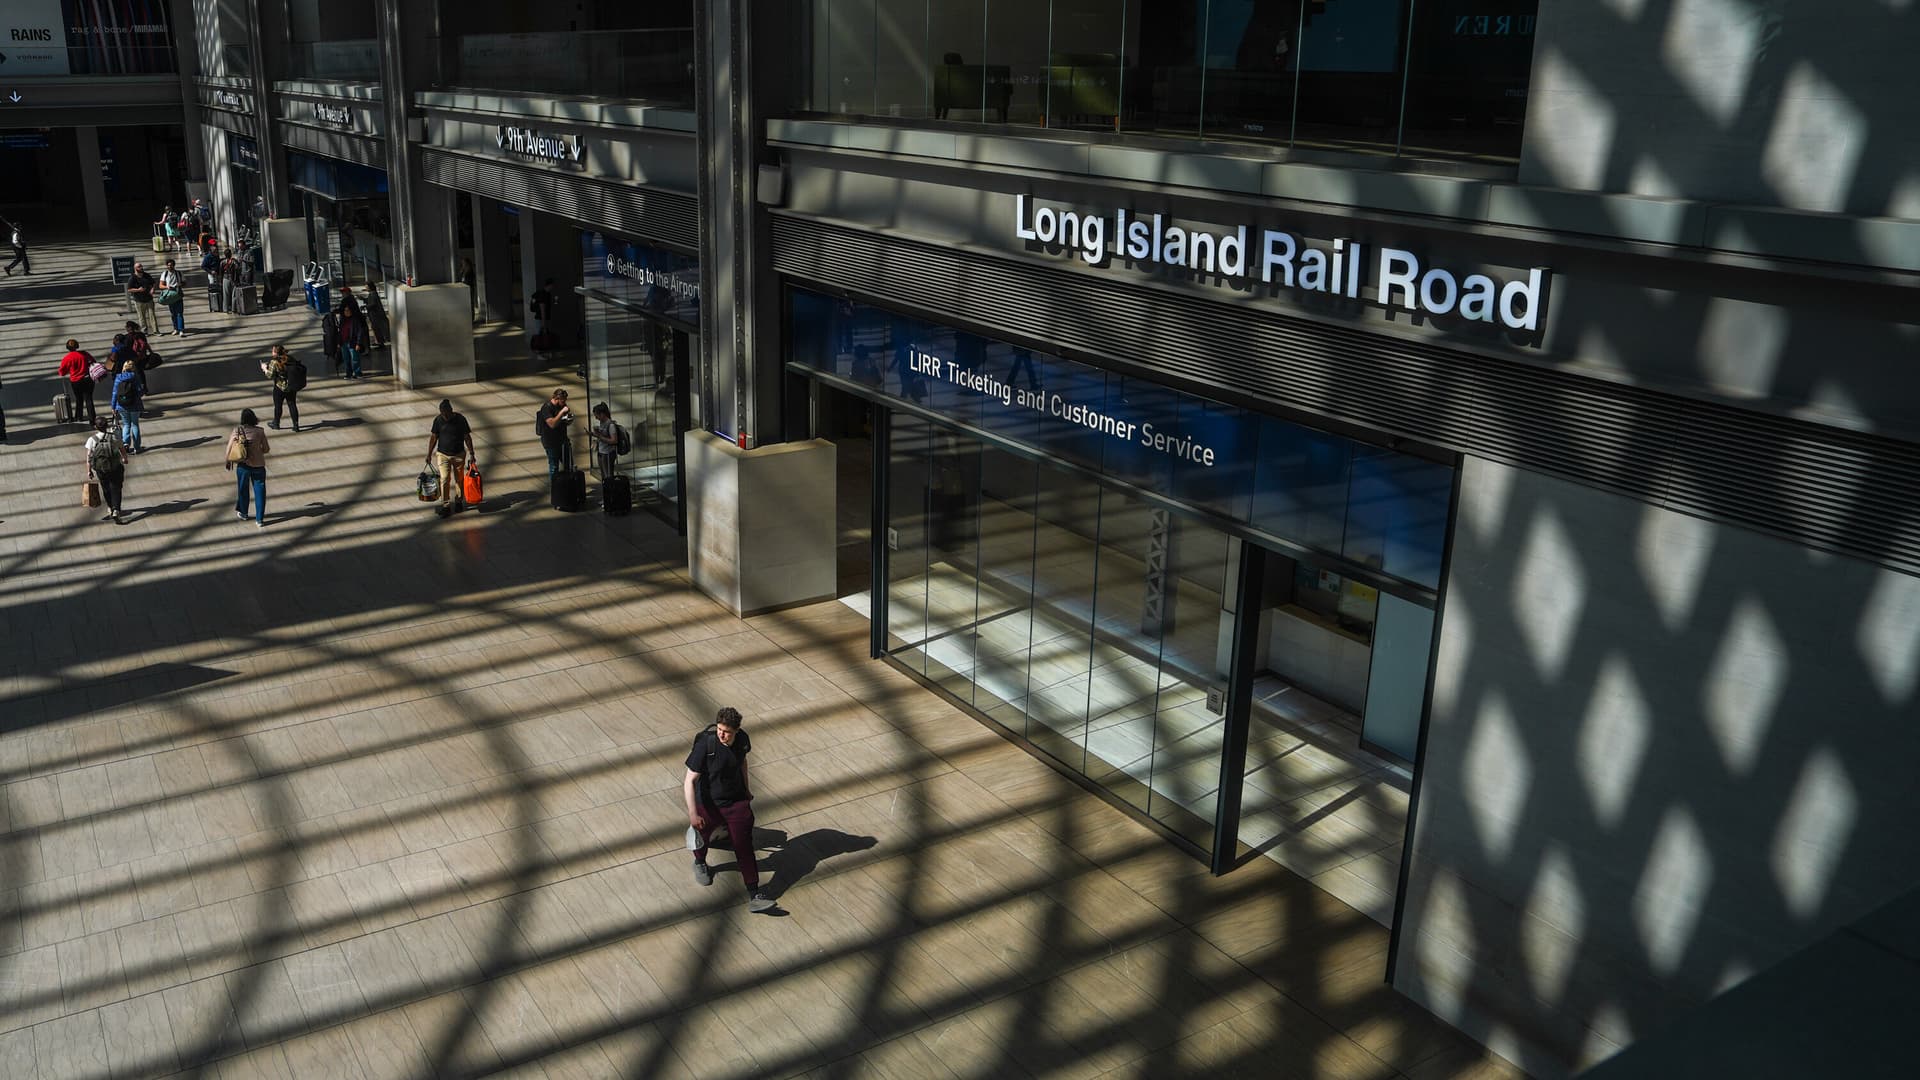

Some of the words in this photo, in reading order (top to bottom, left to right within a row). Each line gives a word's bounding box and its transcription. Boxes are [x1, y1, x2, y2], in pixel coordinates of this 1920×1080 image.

[11, 28, 51, 41] RAINS
[507, 127, 524, 153] 9th
[526, 130, 566, 159] Avenue
[616, 257, 644, 286] Getting
[645, 266, 654, 285] to
[655, 270, 669, 289] the
[670, 273, 701, 299] Airport
[1016, 194, 1104, 264] Long
[1116, 208, 1246, 277] Island
[1262, 229, 1360, 298] Rail
[1378, 247, 1543, 331] Road
[910, 350, 941, 378] LIRR
[947, 360, 1011, 405] Ticketing
[1017, 387, 1045, 412] and
[1051, 394, 1136, 441] Customer
[1141, 422, 1215, 467] Service
